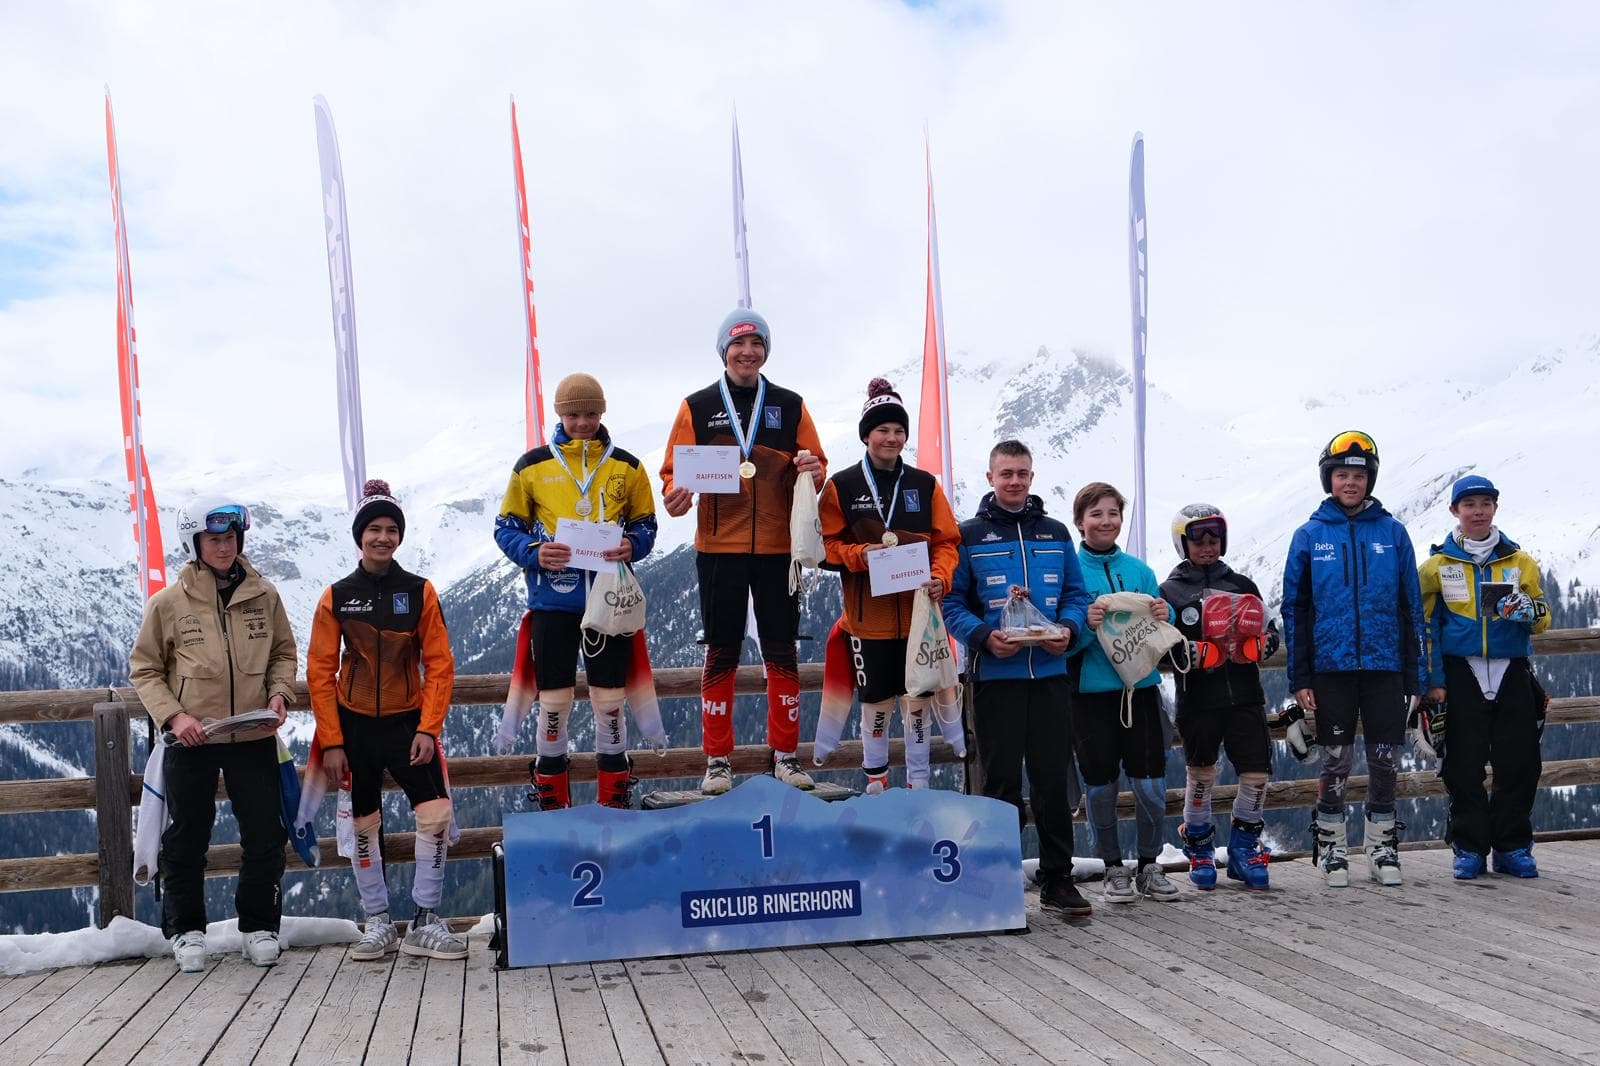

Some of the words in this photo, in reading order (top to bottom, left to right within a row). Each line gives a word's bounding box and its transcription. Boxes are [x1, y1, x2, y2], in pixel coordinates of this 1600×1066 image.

[731, 325, 754, 336] Barilla
[1314, 542, 1335, 551] Beta
[890, 569, 925, 580] RAIFFEISEN
[1125, 617, 1149, 640] Albert
[1112, 621, 1158, 664] Spiess
[547, 712, 559, 735] BKW
[873, 711, 885, 735] BKW
[753, 815, 774, 858] 1
[932, 840, 961, 883] 3
[573, 862, 603, 907] 2
[690, 895, 758, 920] SKICLUB
[763, 888, 854, 915] RINERHORN
